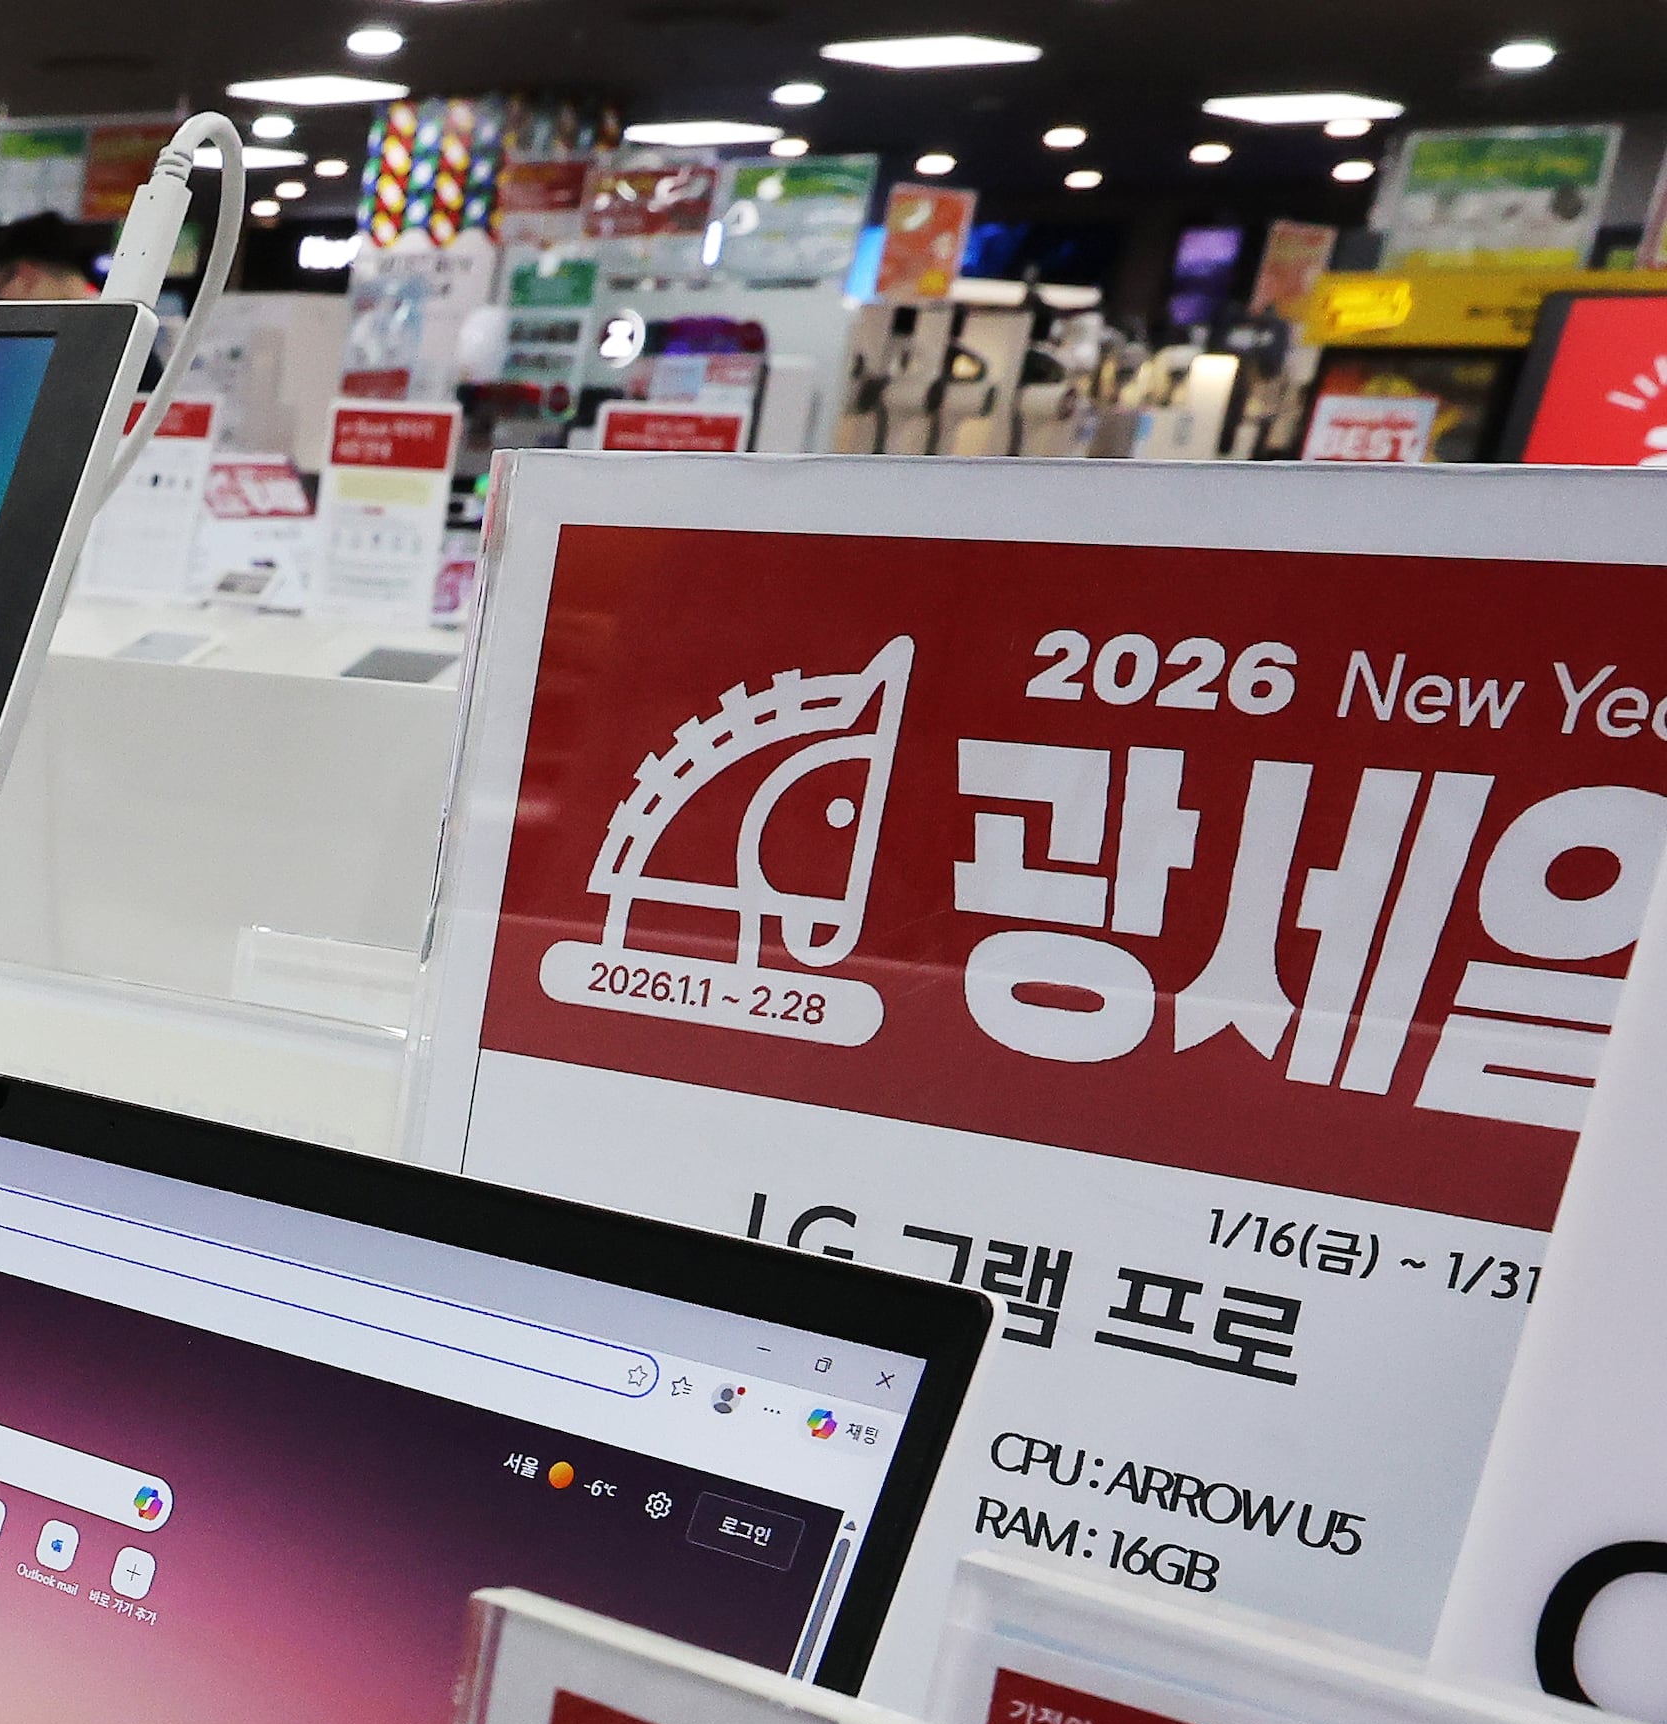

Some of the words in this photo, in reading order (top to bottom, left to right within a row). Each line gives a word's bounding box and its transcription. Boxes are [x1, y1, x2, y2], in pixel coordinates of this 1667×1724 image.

[1025, 627, 1298, 717] 2026
[1336, 649, 1526, 729] New
[588, 960, 714, 1008] 2026.1.1
[750, 981, 828, 1027] 2.28
[1207, 1207, 1381, 1281] 1/16(금)
[1093, 1264, 1305, 1387] 프로
[503, 1451, 540, 1481] 서울
[844, 1421, 881, 1446] 채팅
[990, 1430, 1087, 1493] CPU
[1104, 1460, 1299, 1541] ARROW
[1297, 1499, 1368, 1558] U5
[717, 1515, 773, 1548] 로그인
[974, 1496, 1080, 1560] RAM
[1109, 1529, 1221, 1594] 16GB
[16, 1562, 58, 1589] Outlook
[56, 1579, 80, 1597] mail
[88, 1588, 112, 1609] 바로
[113, 1596, 135, 1618] 가기
[134, 1605, 158, 1627] 추가
